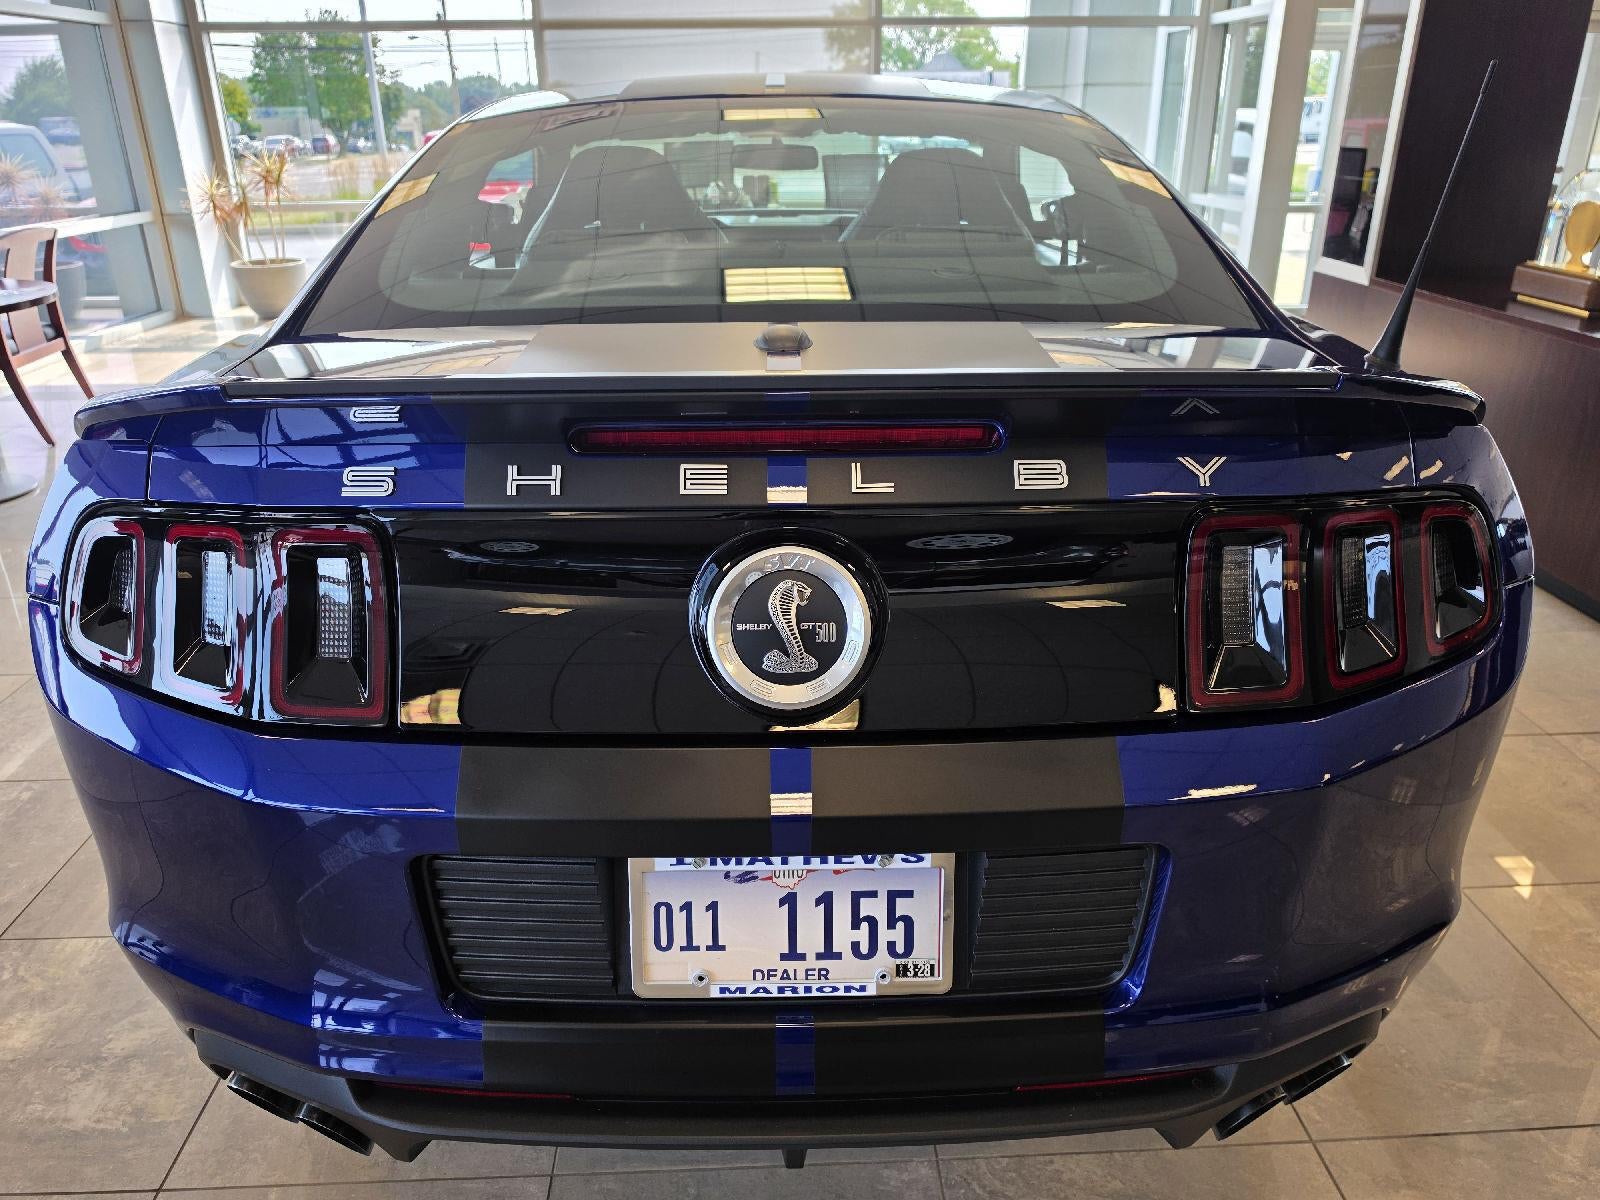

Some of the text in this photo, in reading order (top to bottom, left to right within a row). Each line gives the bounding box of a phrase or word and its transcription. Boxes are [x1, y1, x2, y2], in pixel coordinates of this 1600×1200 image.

[341, 455, 1227, 498] SHELBY
[736, 623, 772, 631] SHELBY
[653, 889, 915, 962] 011 1155
[752, 967, 830, 981] DEALER
[718, 984, 868, 995] MARION
